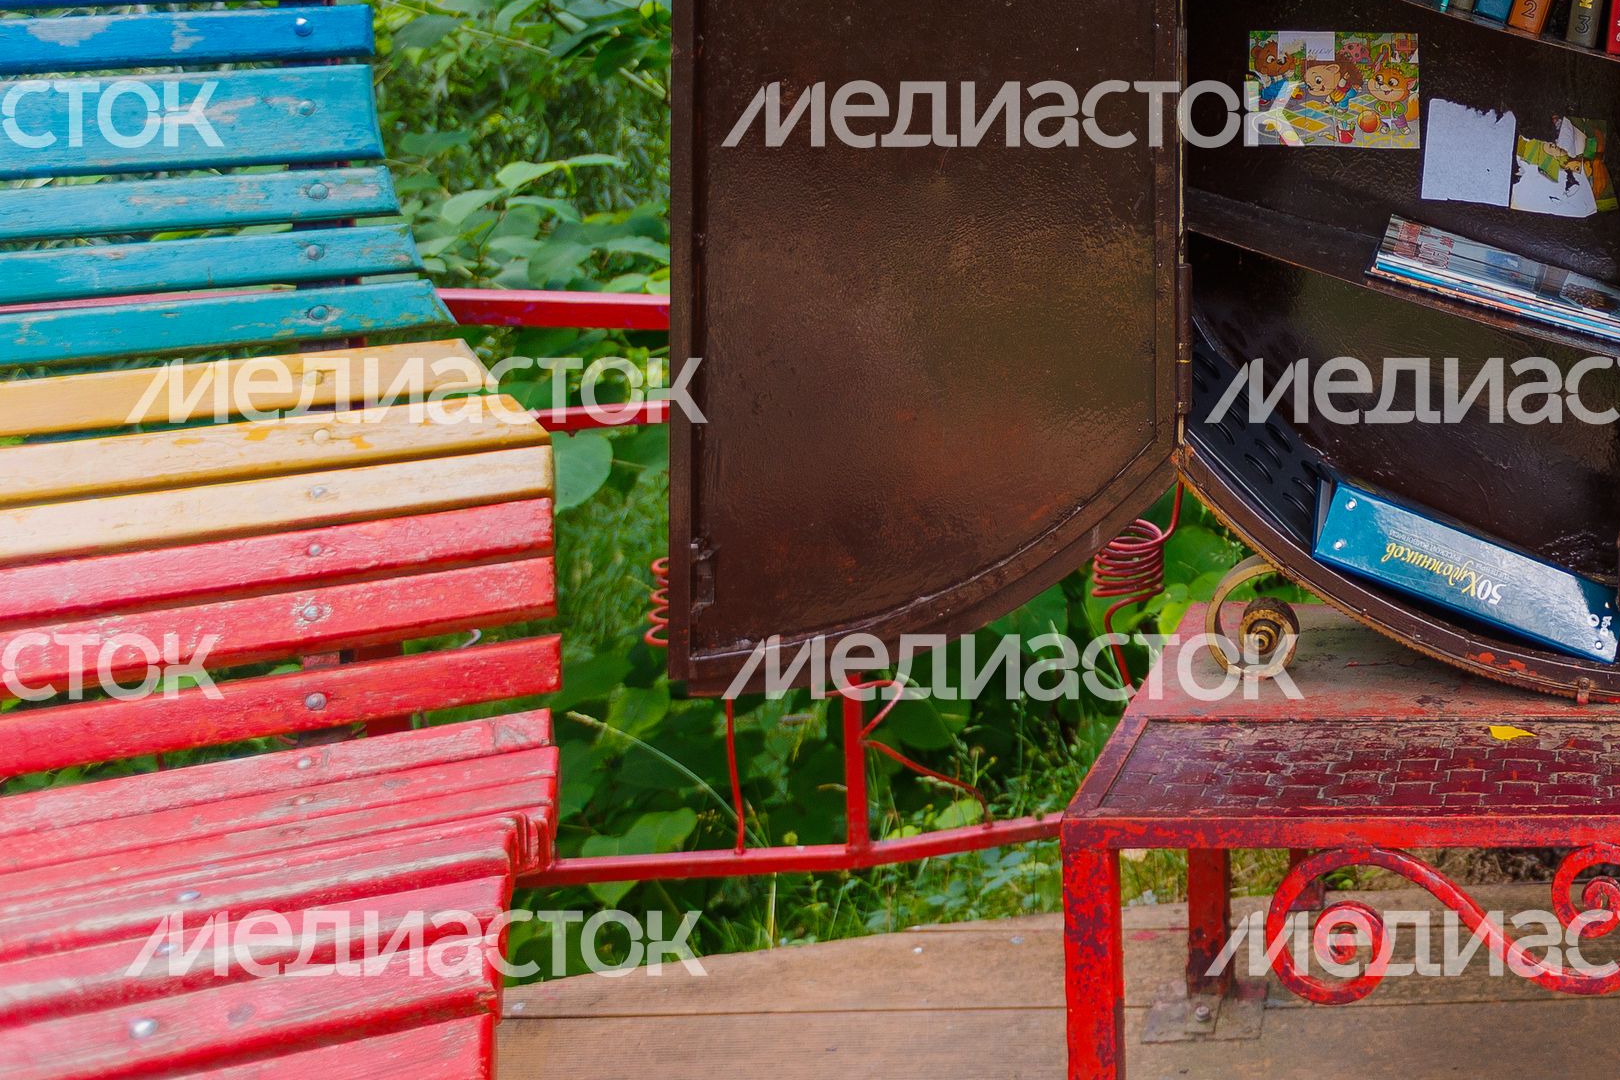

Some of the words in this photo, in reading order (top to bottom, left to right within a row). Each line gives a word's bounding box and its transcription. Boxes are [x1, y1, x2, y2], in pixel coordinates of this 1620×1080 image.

[1521, 0, 1538, 19] 2
[1575, 15, 1591, 34] 3
[1380, 542, 1482, 595] Художников
[1477, 579, 1506, 605] 50
